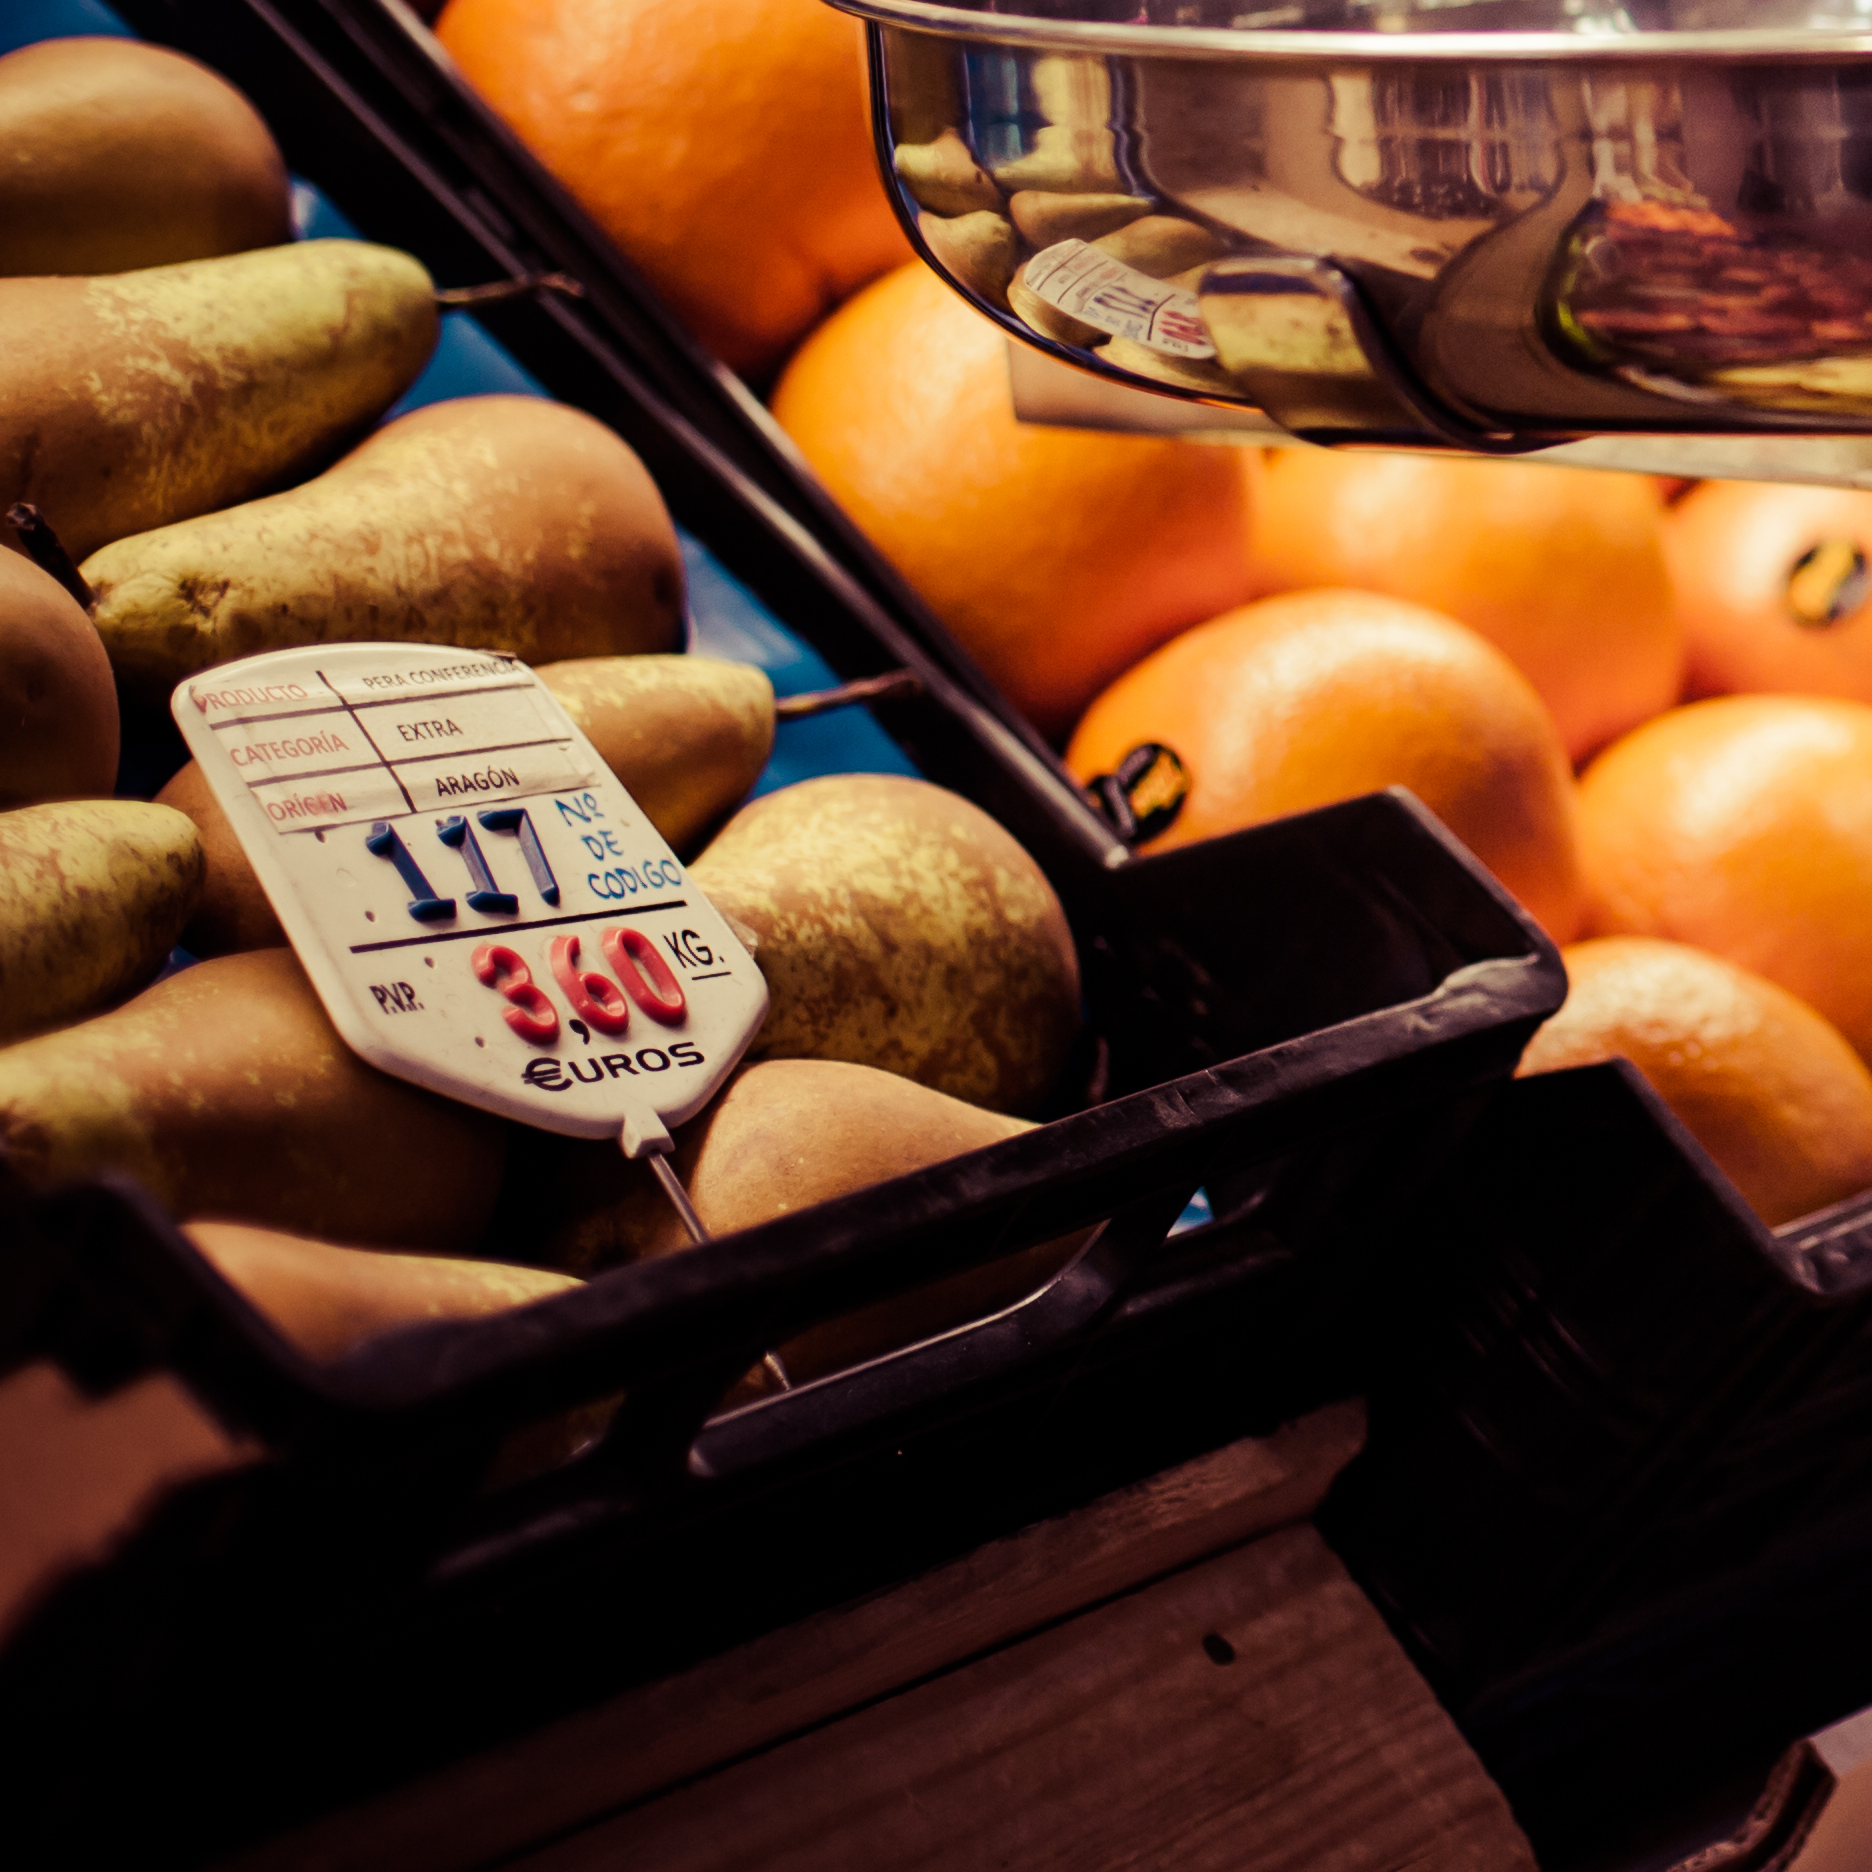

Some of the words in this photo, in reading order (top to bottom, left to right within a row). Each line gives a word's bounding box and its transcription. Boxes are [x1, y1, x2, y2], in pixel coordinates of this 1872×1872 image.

[362, 668, 409, 691] PERA
[396, 718, 463, 743] EXTRA
[230, 730, 350, 767] CATEGORÍA
[435, 765, 520, 797] ARAGÓN
[581, 830, 624, 861] DE
[365, 806, 560, 924] 117
[587, 859, 682, 900] CODIGO
